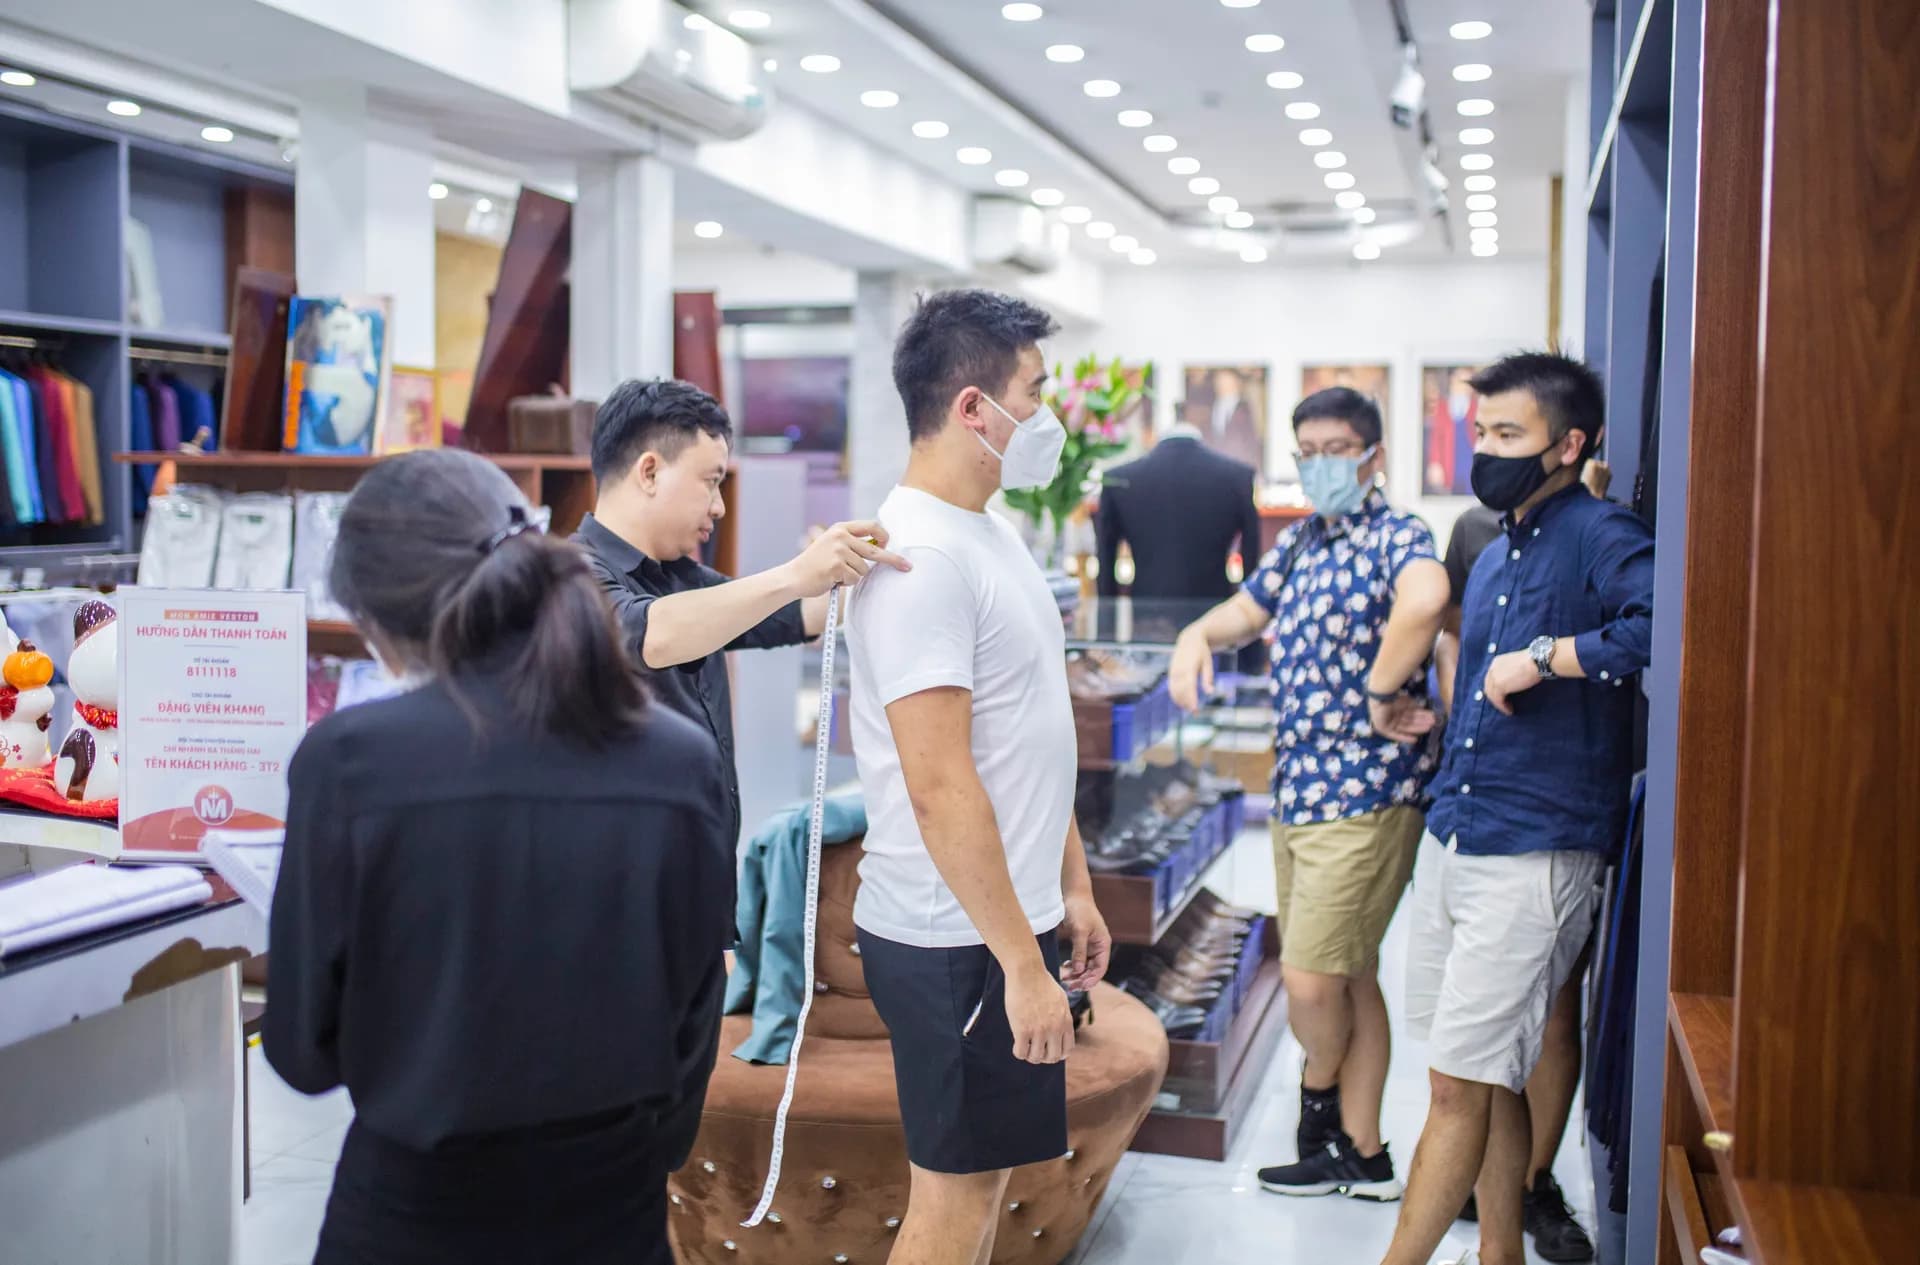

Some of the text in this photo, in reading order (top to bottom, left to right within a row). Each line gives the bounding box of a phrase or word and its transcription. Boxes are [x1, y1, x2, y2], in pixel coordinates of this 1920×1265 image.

[210, 628, 252, 640] THANH
[255, 626, 287, 641] TOÁN
[186, 666, 237, 679] 8111118
[158, 700, 265, 716] ĐẶNG VIÊN KHANG
[144, 755, 167, 769] TÊN
[170, 756, 210, 770] KHÁCH
[214, 757, 247, 772] HÀNG
[259, 761, 280, 773] 3T2
